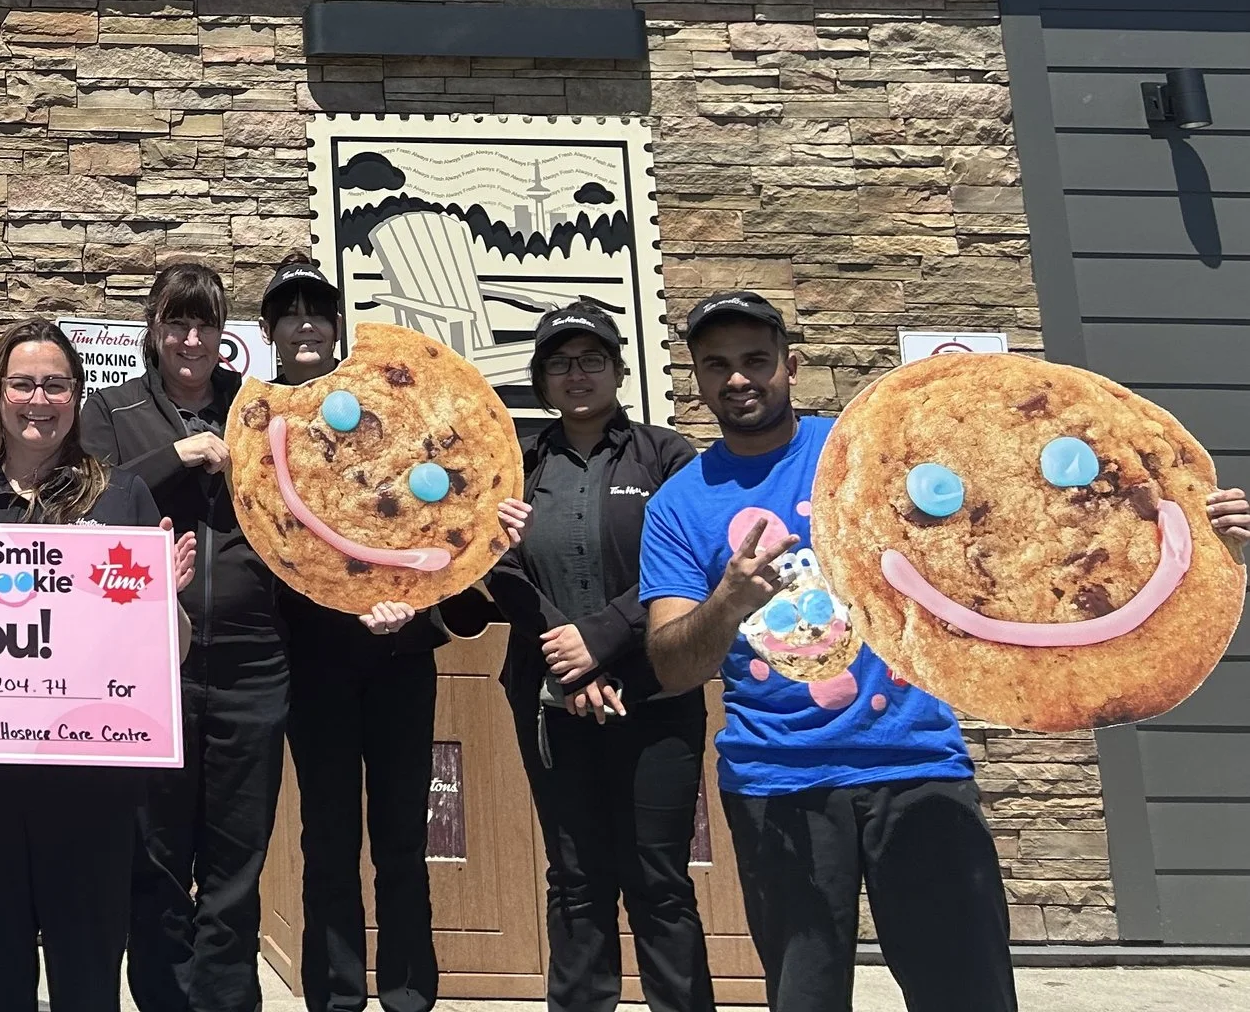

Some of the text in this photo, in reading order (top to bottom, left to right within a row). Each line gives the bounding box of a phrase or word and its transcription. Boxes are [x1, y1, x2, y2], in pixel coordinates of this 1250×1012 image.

[70, 329, 142, 347] Tim Horton
[78, 351, 137, 368] SMOKING
[85, 369, 128, 384] IS NOT
[96, 563, 147, 591] Tims
[106, 679, 137, 698] for
[0, 721, 51, 741] Hospice
[57, 723, 94, 742] Care
[101, 725, 152, 743] Centre
